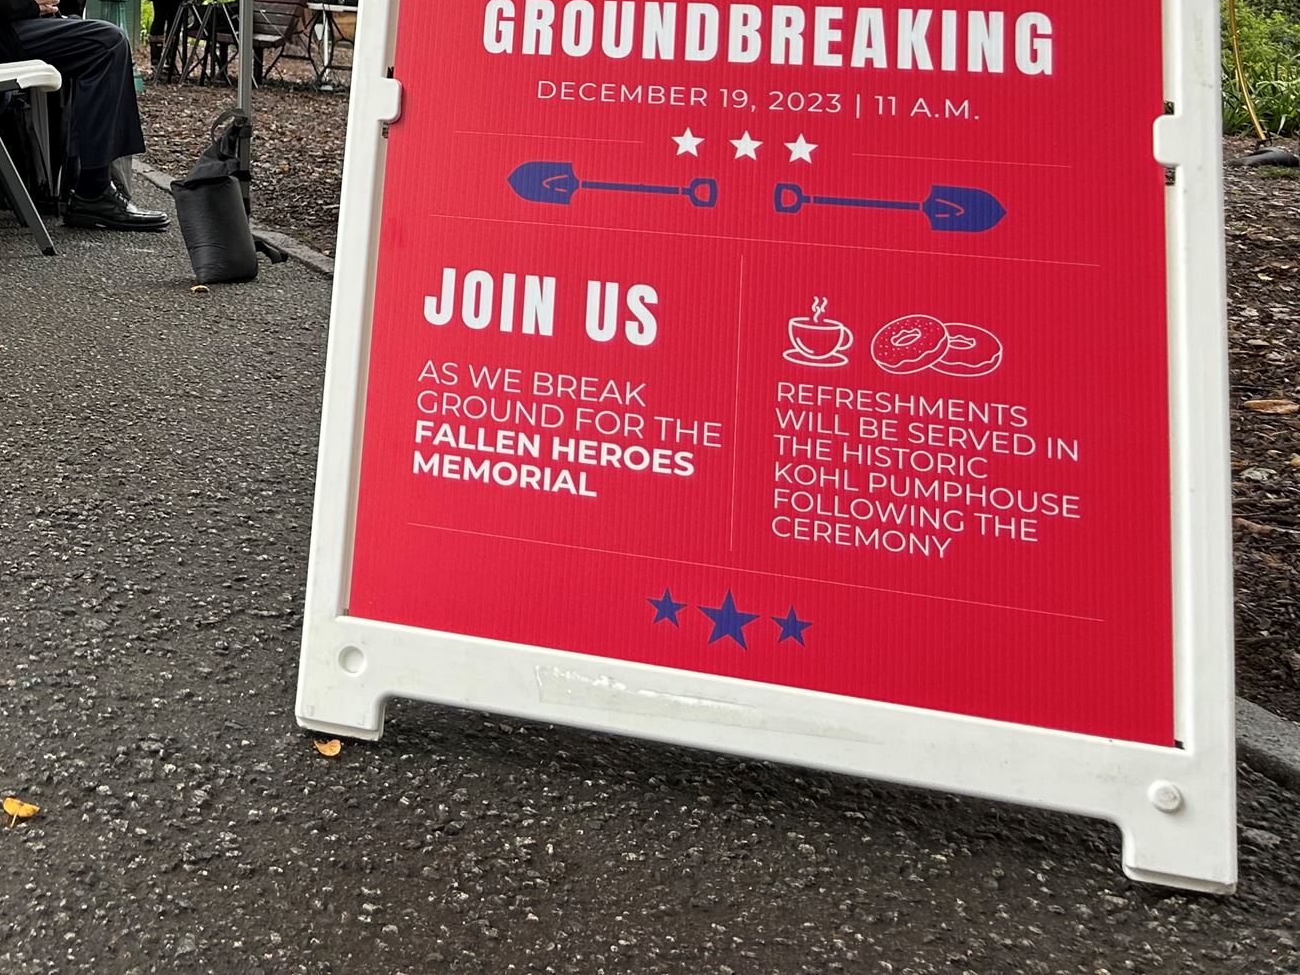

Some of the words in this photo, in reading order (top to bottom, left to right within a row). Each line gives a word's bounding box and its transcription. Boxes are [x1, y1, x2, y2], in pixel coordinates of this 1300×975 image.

[537, 80, 708, 107] DECEMBER
[719, 88, 756, 113] 19,
[768, 90, 842, 113] 2023
[874, 95, 896, 116] 11
[910, 97, 981, 121] A.M.
[423, 267, 557, 337] JOIN
[585, 279, 659, 347] US
[417, 359, 459, 386] AS
[468, 364, 522, 394] WE
[532, 371, 647, 408] BREAK
[777, 381, 1028, 428] REFRESHMENTS
[416, 389, 565, 429] GROUND
[575, 407, 645, 439] FOR
[653, 416, 722, 448] THE
[775, 407, 850, 436] WILL
[859, 416, 898, 442] BE
[907, 422, 1036, 456] SERVED
[1047, 437, 1078, 462] IN
[414, 419, 541, 459] FALLEN
[551, 436, 695, 477] HEROES
[773, 434, 832, 461] THE
[843, 441, 988, 479] HISTORIC
[412, 450, 598, 498] MEMORIAL
[774, 461, 859, 492] KOHL
[868, 472, 1081, 519] PUMPHOUSE
[771, 515, 952, 558] CEREMONY
[773, 488, 965, 532] FOLLOWING
[973, 512, 1038, 542] THE
